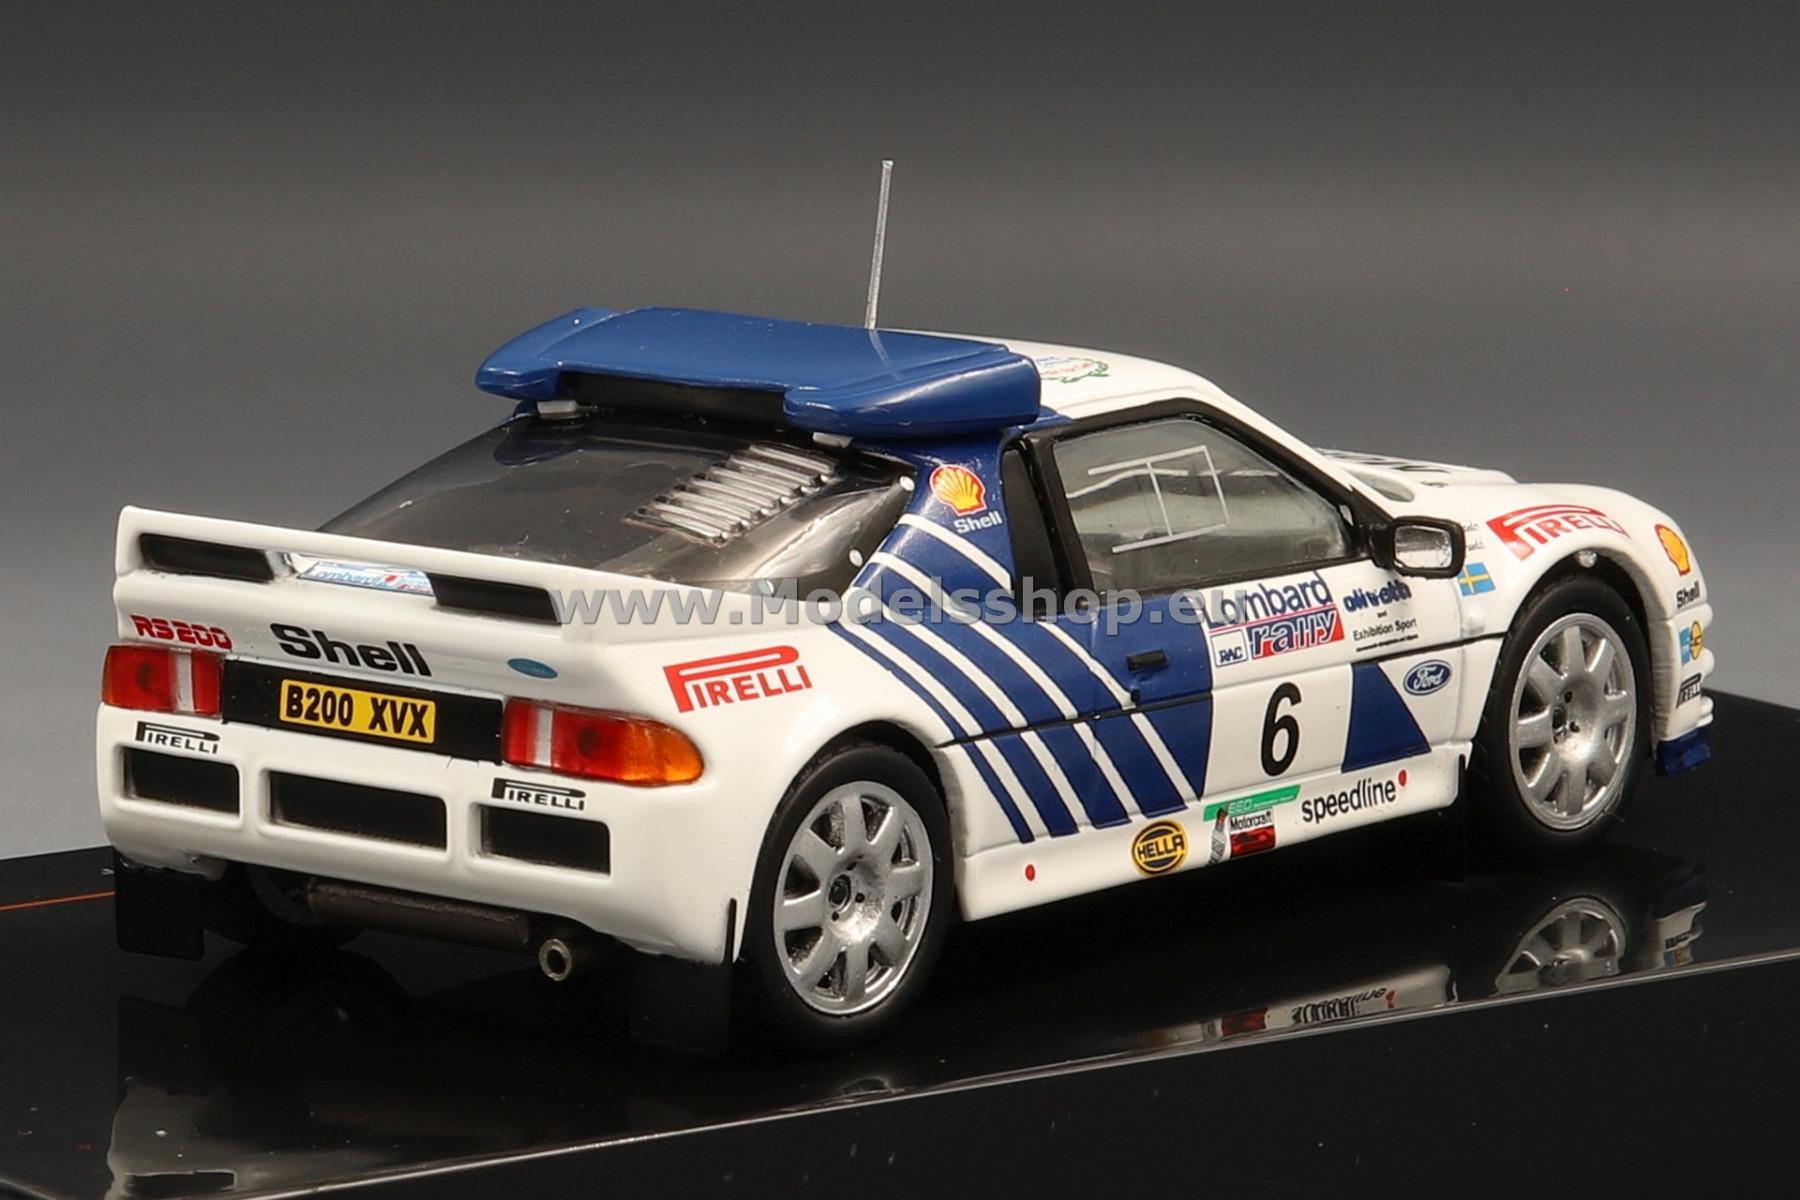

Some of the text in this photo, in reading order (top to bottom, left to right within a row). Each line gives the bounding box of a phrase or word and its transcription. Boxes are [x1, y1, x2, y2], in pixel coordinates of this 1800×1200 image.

[954, 510, 1003, 534] Shell
[1205, 570, 1334, 628] Lombard
[130, 614, 233, 650] RS200
[1252, 609, 1337, 657] rally
[1352, 617, 1417, 641] Exhibition Sport
[269, 622, 433, 677] Shell
[1219, 649, 1243, 664] RAC
[663, 644, 813, 713] PIRELLI
[1413, 666, 1445, 692] Ford
[286, 684, 428, 739] B200 XVX
[1260, 682, 1302, 777] 6
[135, 720, 221, 755] PIRELLI
[490, 777, 586, 811] PIRELLI
[1301, 777, 1397, 824] speedline
[1137, 837, 1185, 861] HELLA
